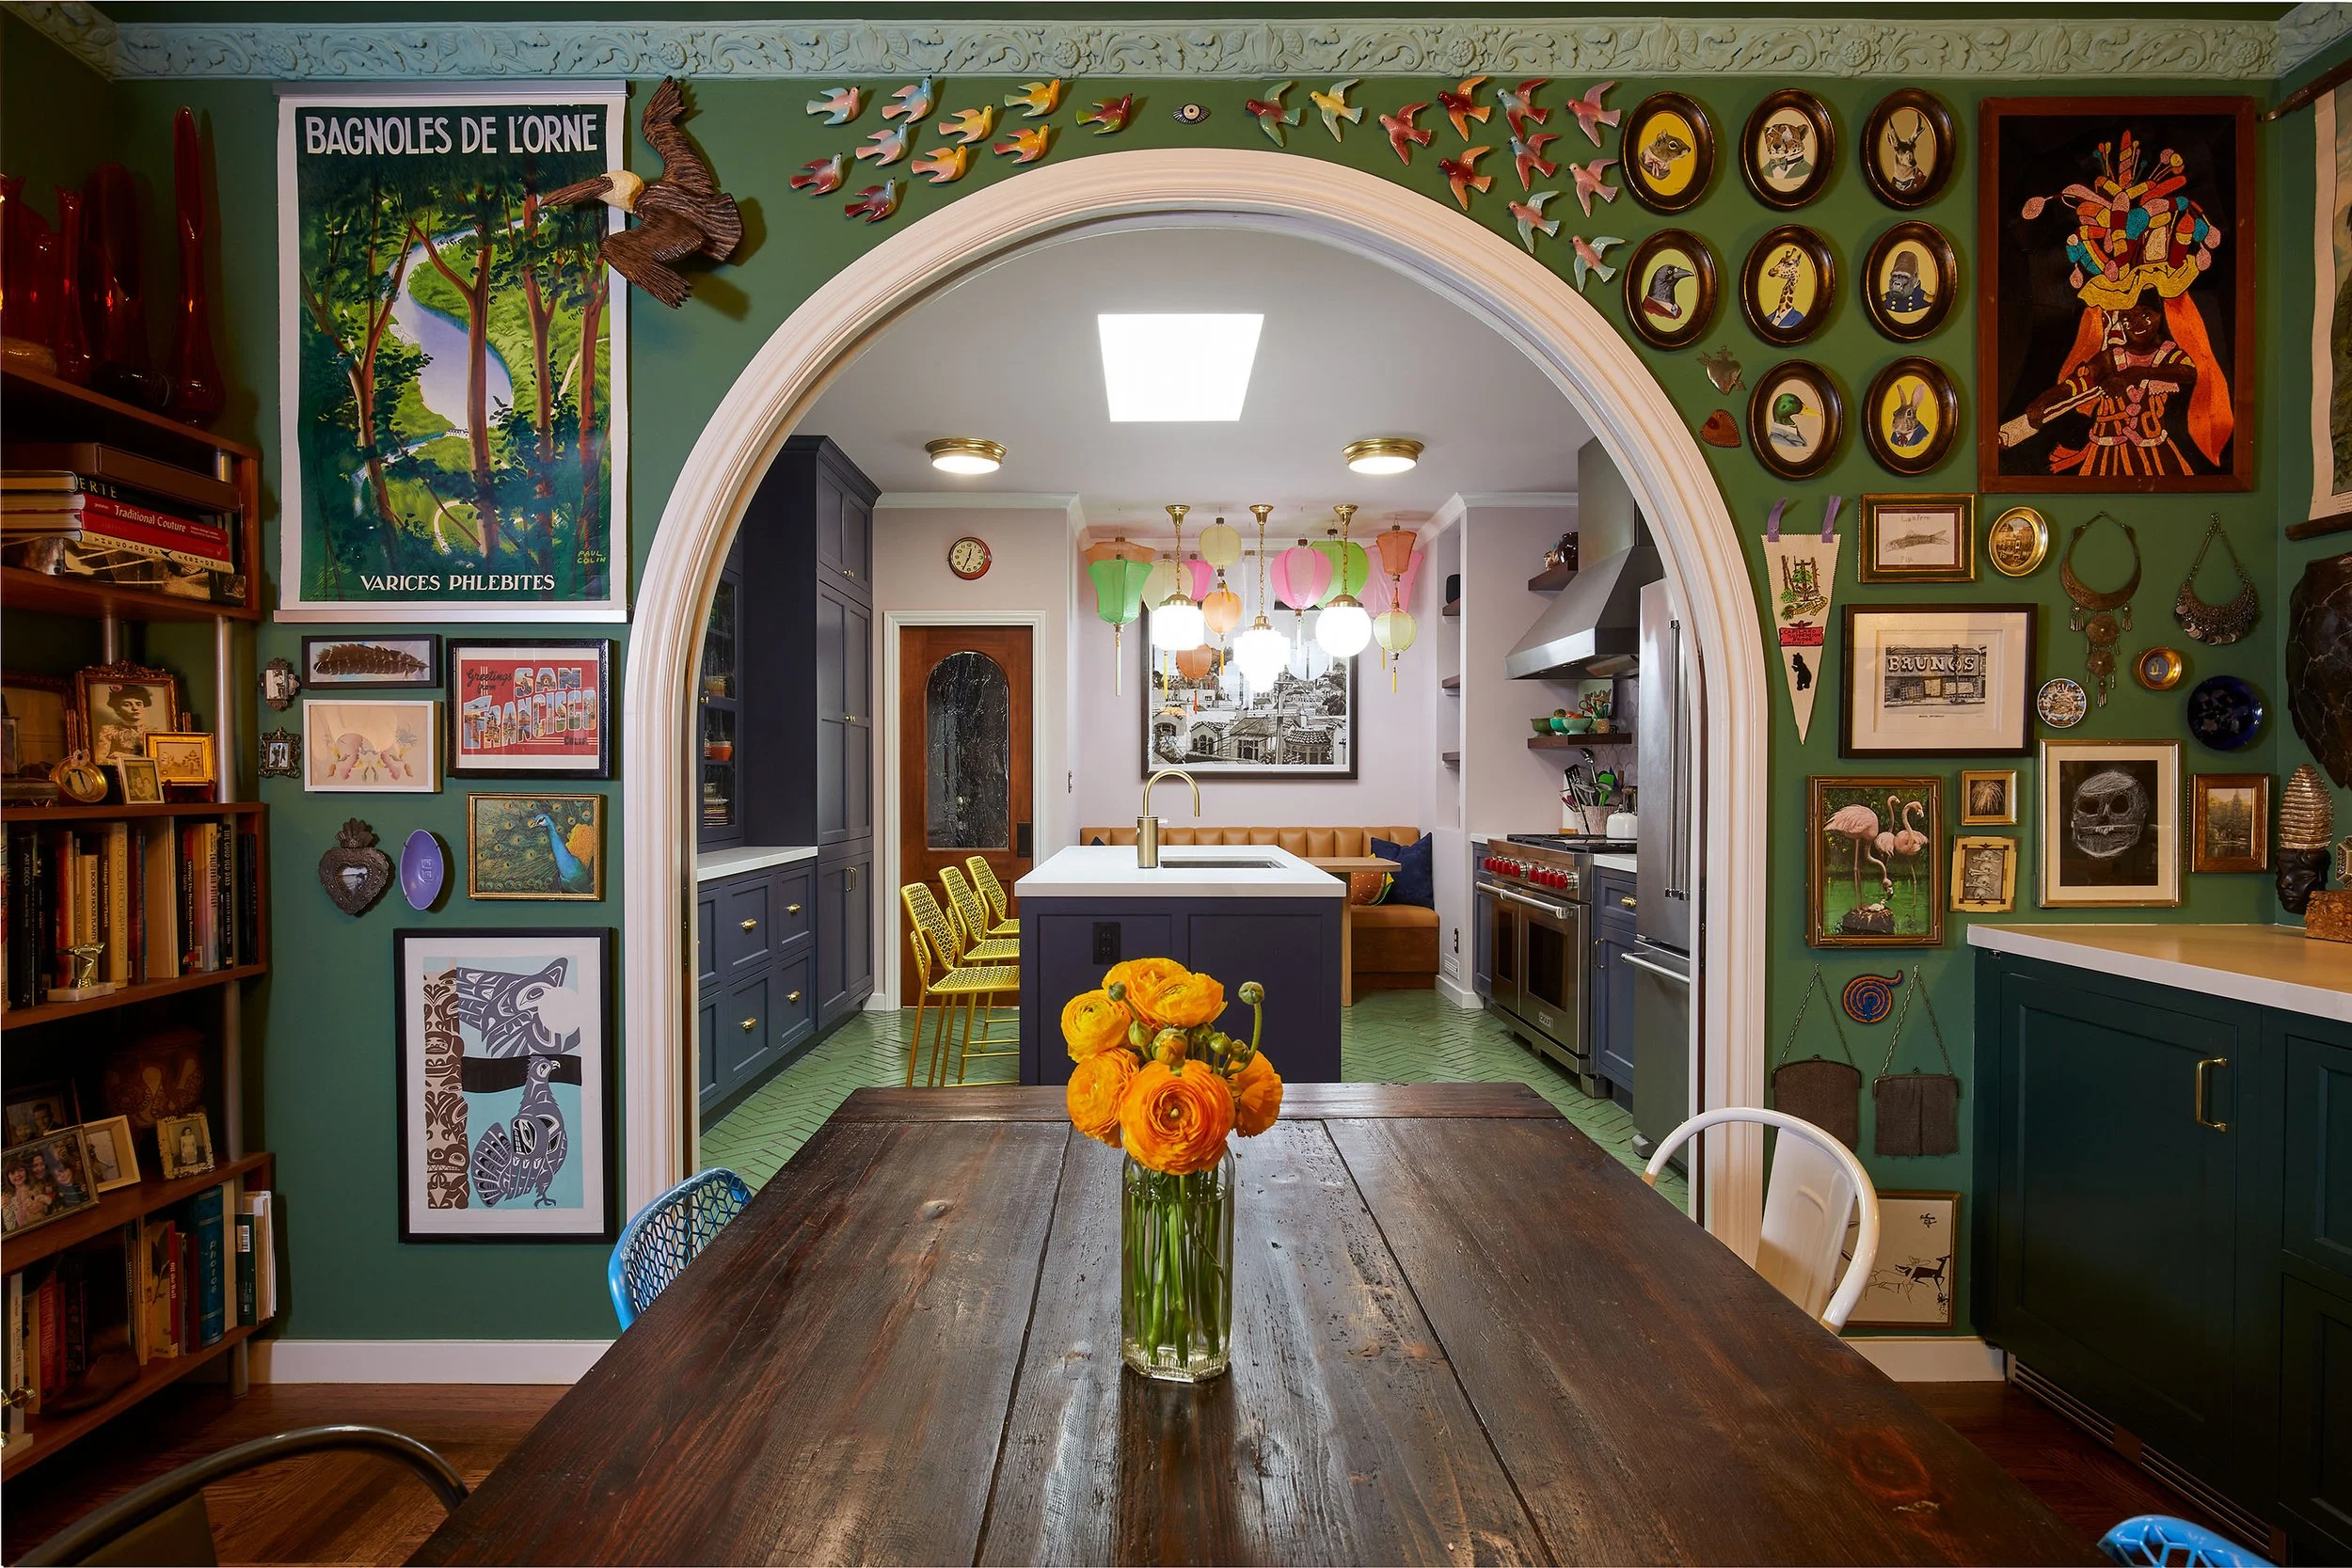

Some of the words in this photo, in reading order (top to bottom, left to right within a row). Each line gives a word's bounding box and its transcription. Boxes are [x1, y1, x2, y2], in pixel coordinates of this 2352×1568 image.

[304, 115, 453, 156] BAGNOLES
[460, 115, 497, 155] DE
[508, 113, 598, 154] L'ORNE
[114, 504, 155, 526] Traditional
[156, 515, 186, 533] Couture
[116, 542, 145, 553] COLOR
[359, 575, 440, 592] VARICES
[449, 574, 555, 592] PHLEBITES
[467, 667, 513, 688] Greetings
[514, 667, 582, 697] SAN
[478, 684, 496, 694] from
[463, 689, 597, 750] FRANCISCO
[223, 830, 231, 840] THE
